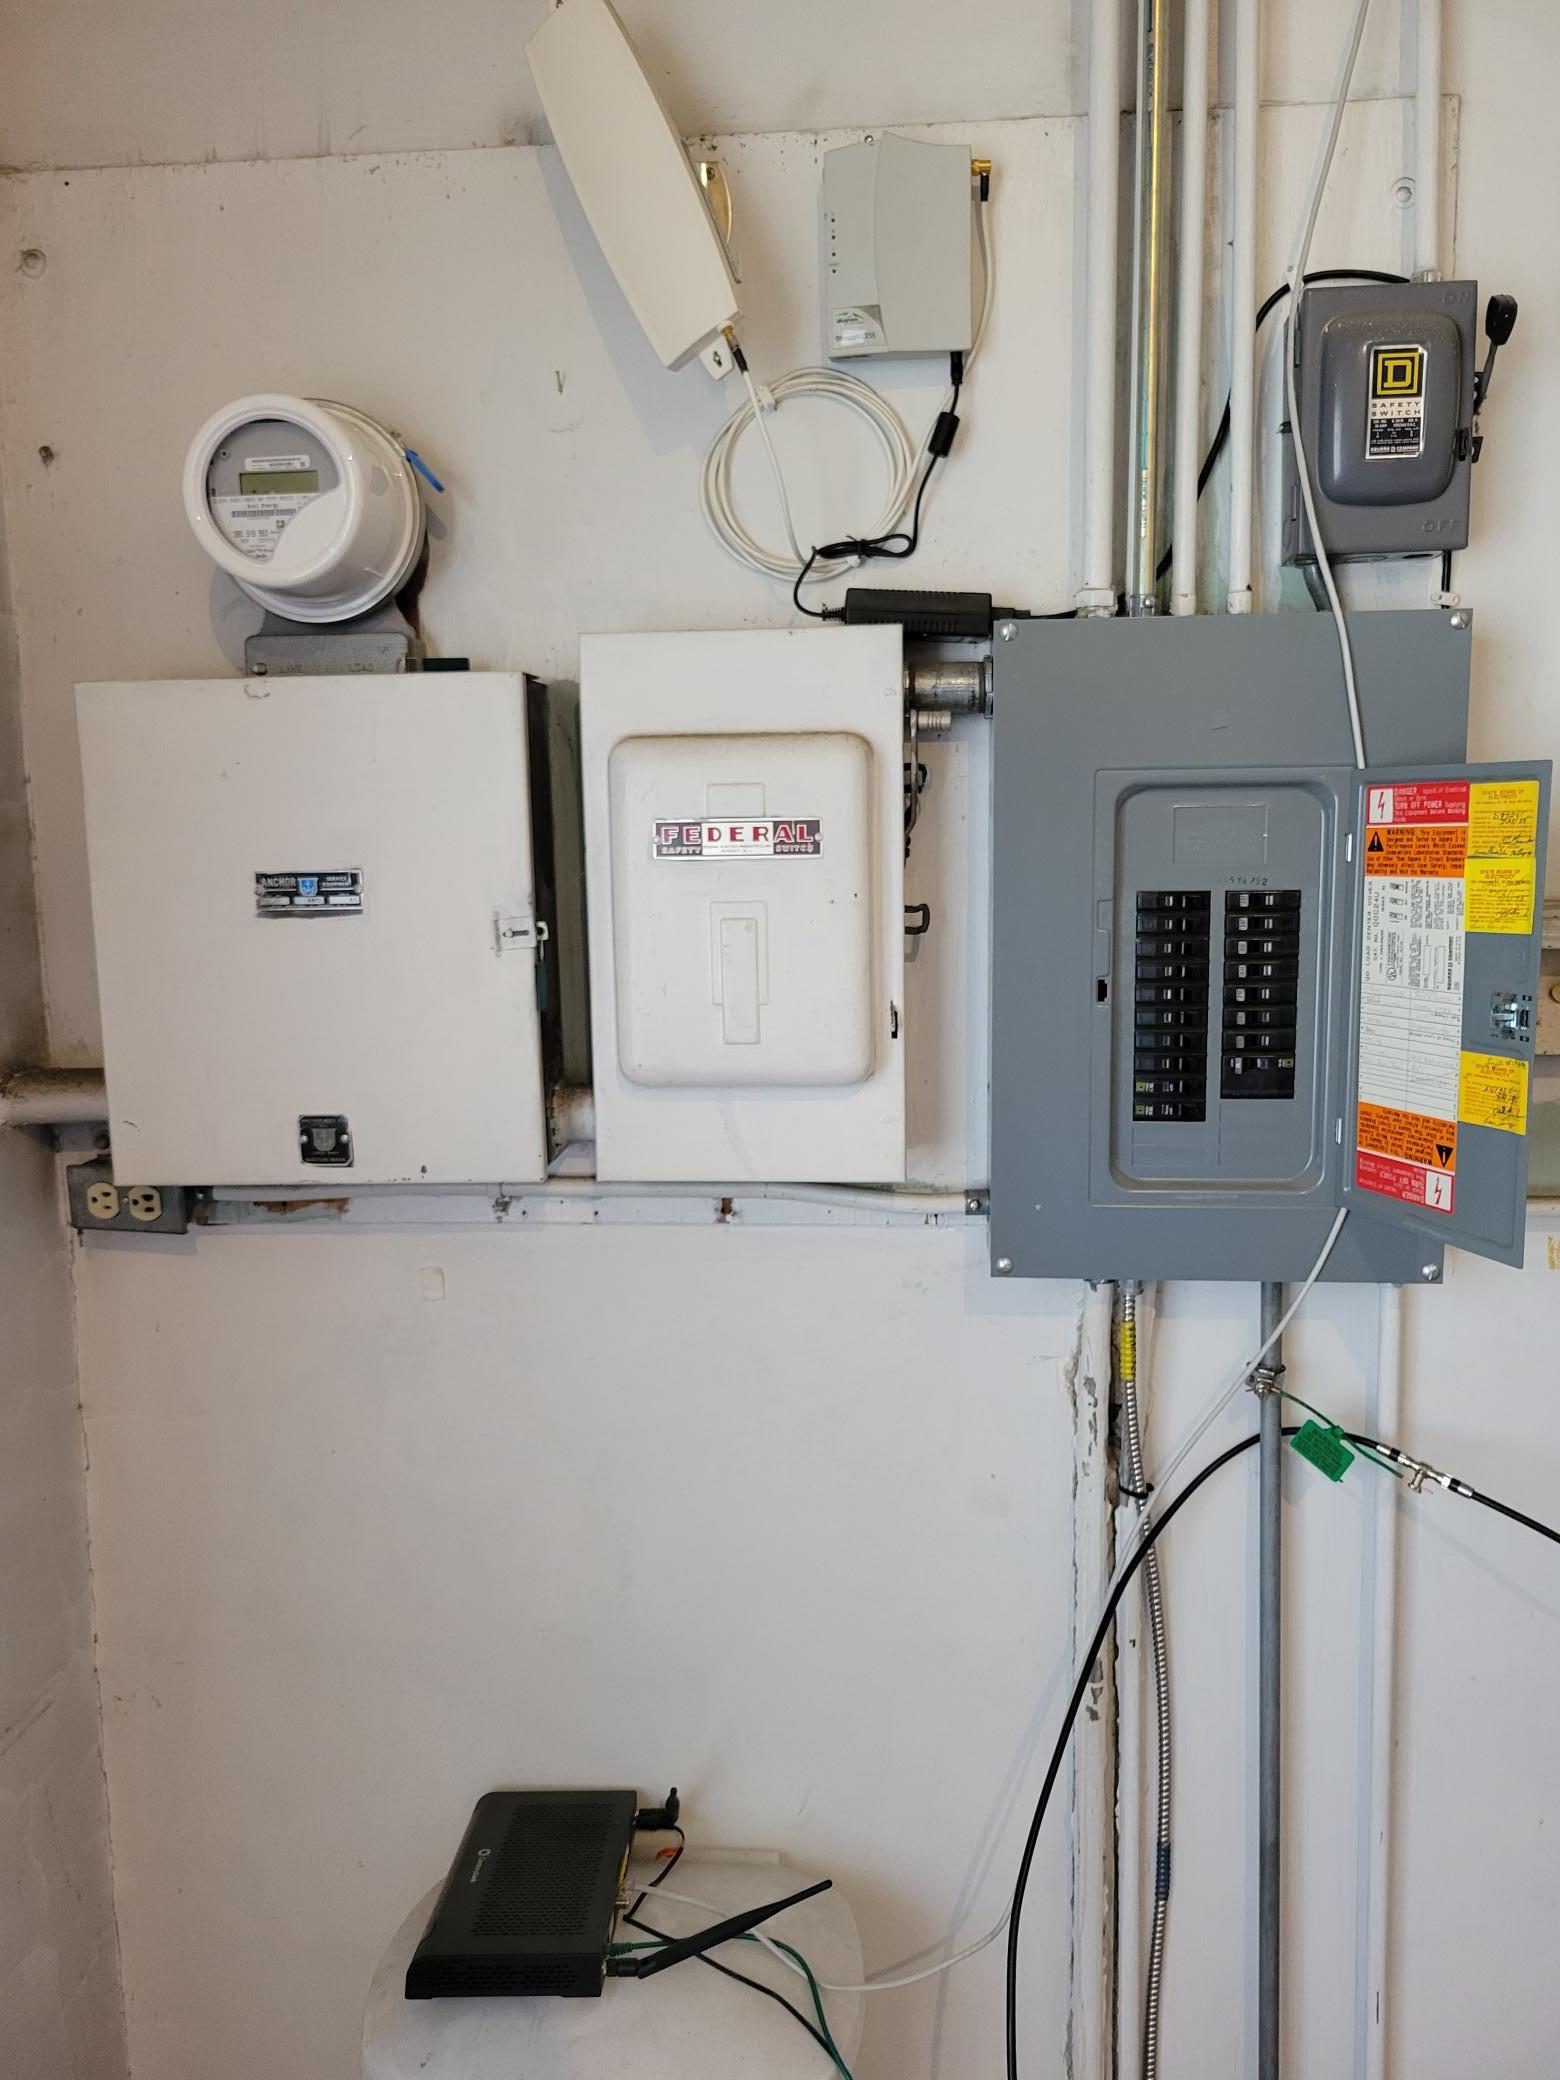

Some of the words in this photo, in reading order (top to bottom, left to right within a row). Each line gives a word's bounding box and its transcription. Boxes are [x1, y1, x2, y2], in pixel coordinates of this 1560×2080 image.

[1371, 401, 1421, 409] SAFETY
[1371, 409, 1421, 417] SWITCH
[1422, 519, 1461, 533] OFF
[660, 823, 814, 845] FEDERAL
[661, 846, 701, 855] SAFETY
[261, 877, 297, 888] ANCHOR
